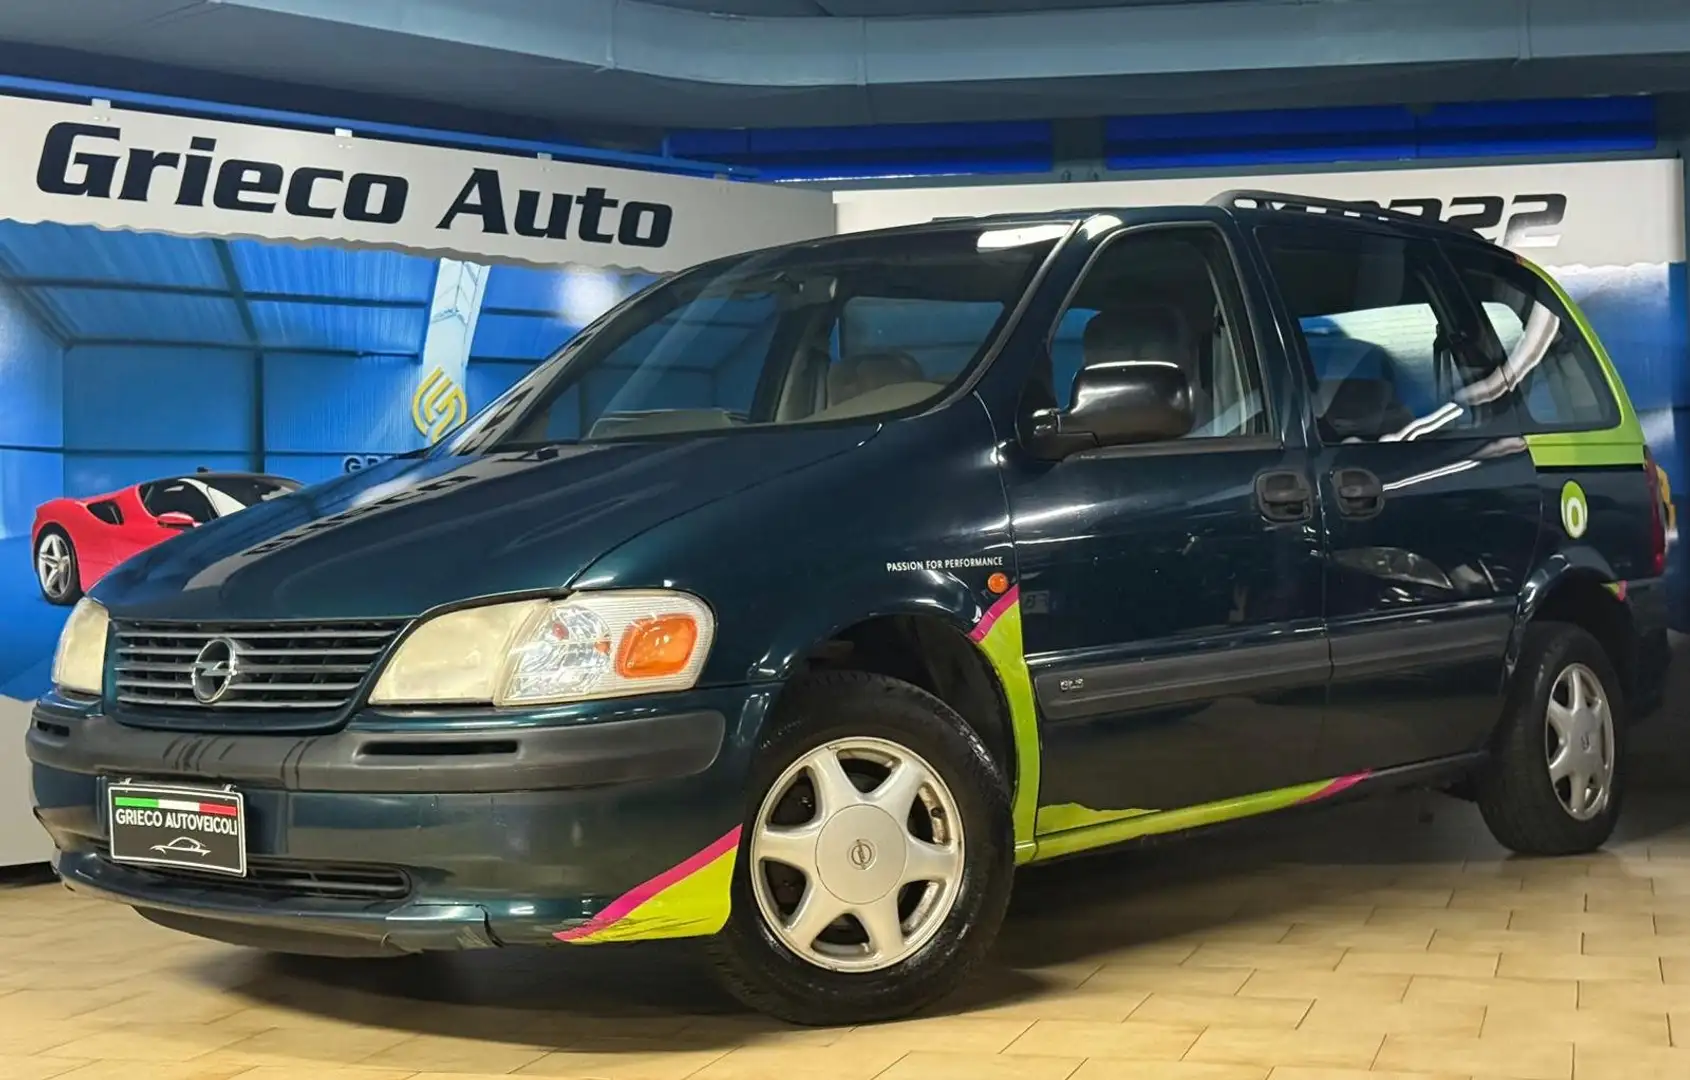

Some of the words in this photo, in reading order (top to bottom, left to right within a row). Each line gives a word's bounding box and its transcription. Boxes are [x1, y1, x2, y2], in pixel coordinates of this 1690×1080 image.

[36, 121, 409, 225] Grieco
[435, 167, 673, 248] Auto
[886, 561, 924, 572] PASSION
[926, 559, 943, 570] FOR
[944, 556, 1004, 569] PERFORMANCE
[115, 808, 163, 827] GRIECO
[164, 811, 238, 836] AUTOVEICOLI
